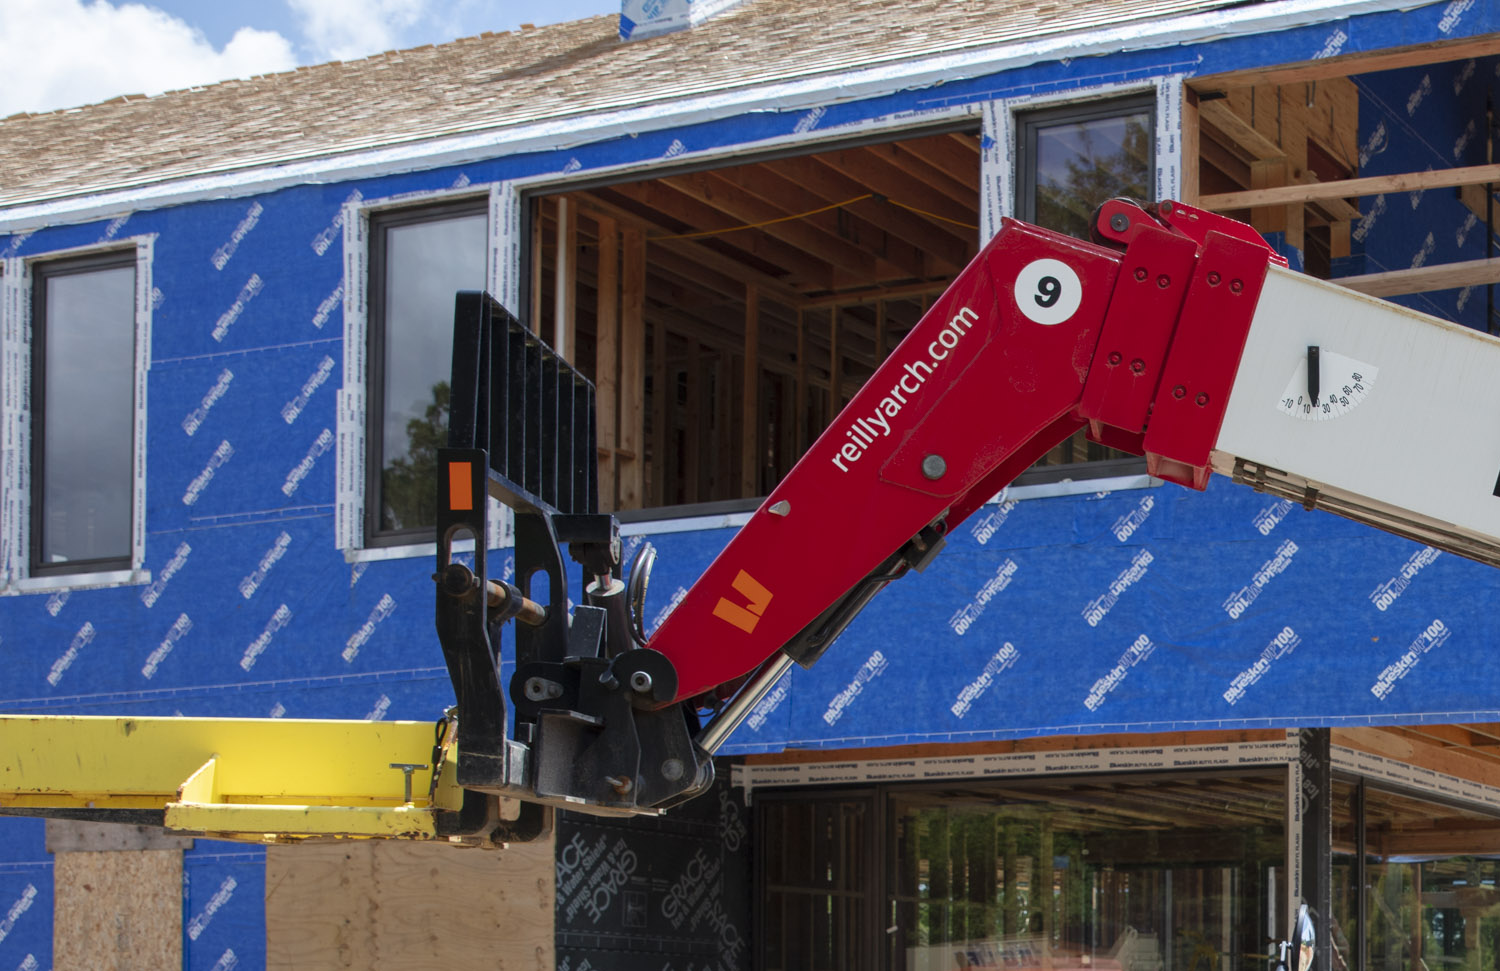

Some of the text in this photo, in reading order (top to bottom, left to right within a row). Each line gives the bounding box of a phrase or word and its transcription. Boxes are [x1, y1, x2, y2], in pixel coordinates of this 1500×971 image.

[1034, 276, 1062, 308] 9
[831, 306, 980, 473] reillyarch.com
[1329, 394, 1338, 405] 40
[1321, 403, 1331, 414] 30
[555, 832, 589, 887] ACE
